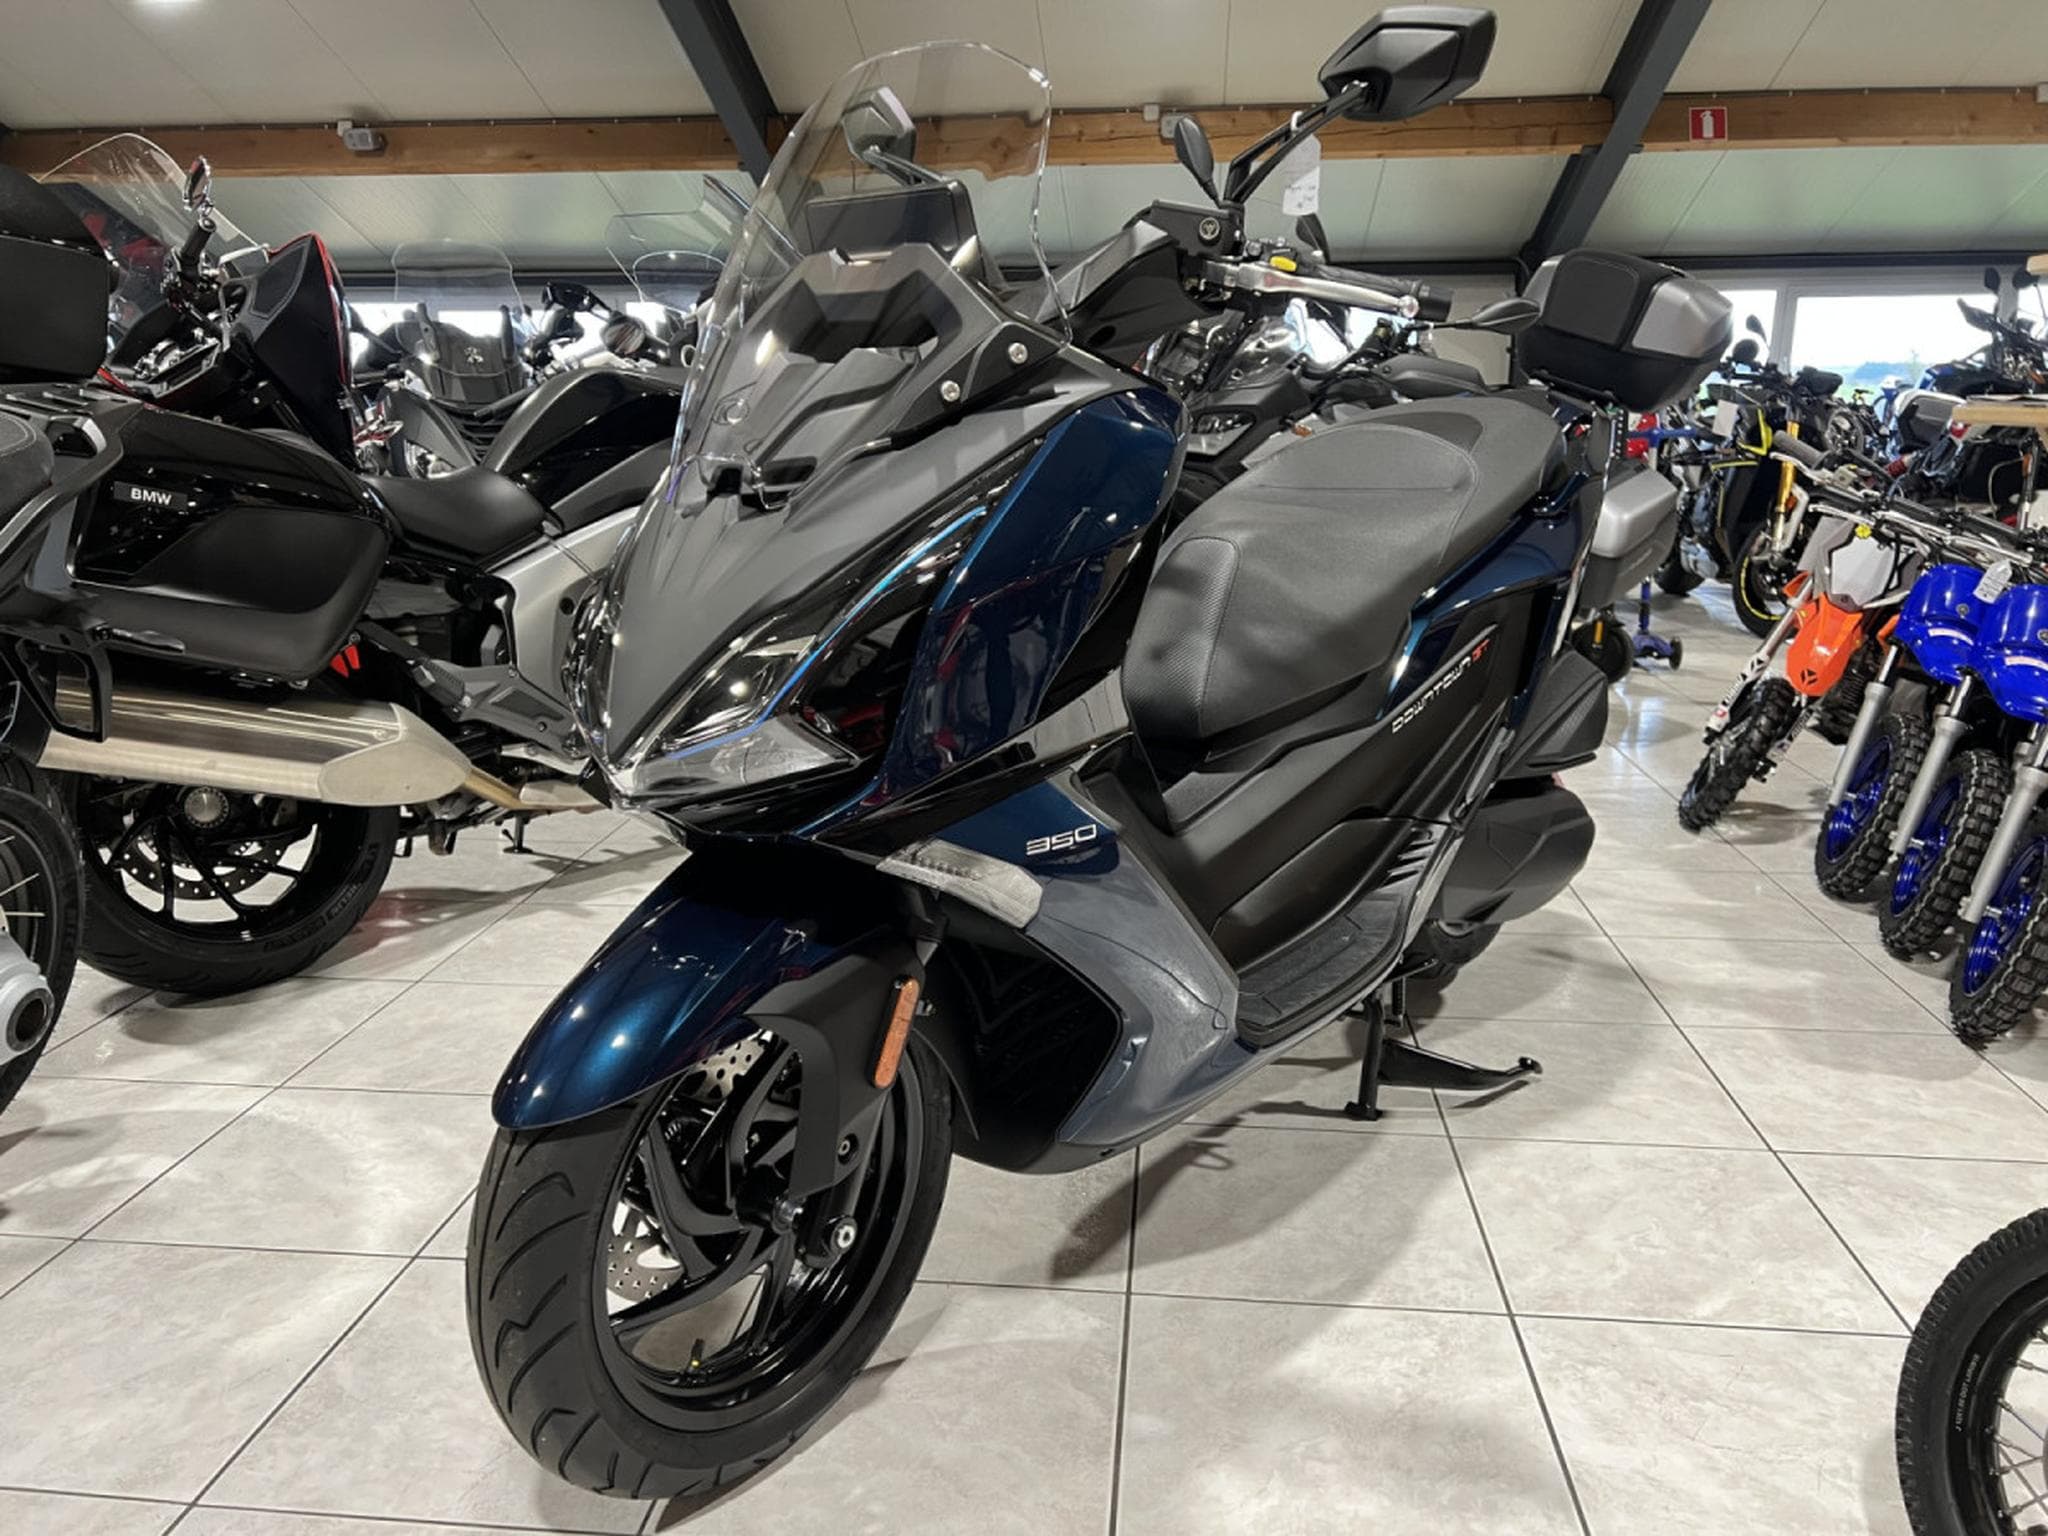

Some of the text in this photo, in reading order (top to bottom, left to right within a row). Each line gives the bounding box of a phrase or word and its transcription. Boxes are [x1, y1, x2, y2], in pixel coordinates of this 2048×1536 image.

[130, 487, 172, 505] BMW
[1392, 656, 1471, 734] DOWNTOWN
[1026, 823, 1097, 856] 350
